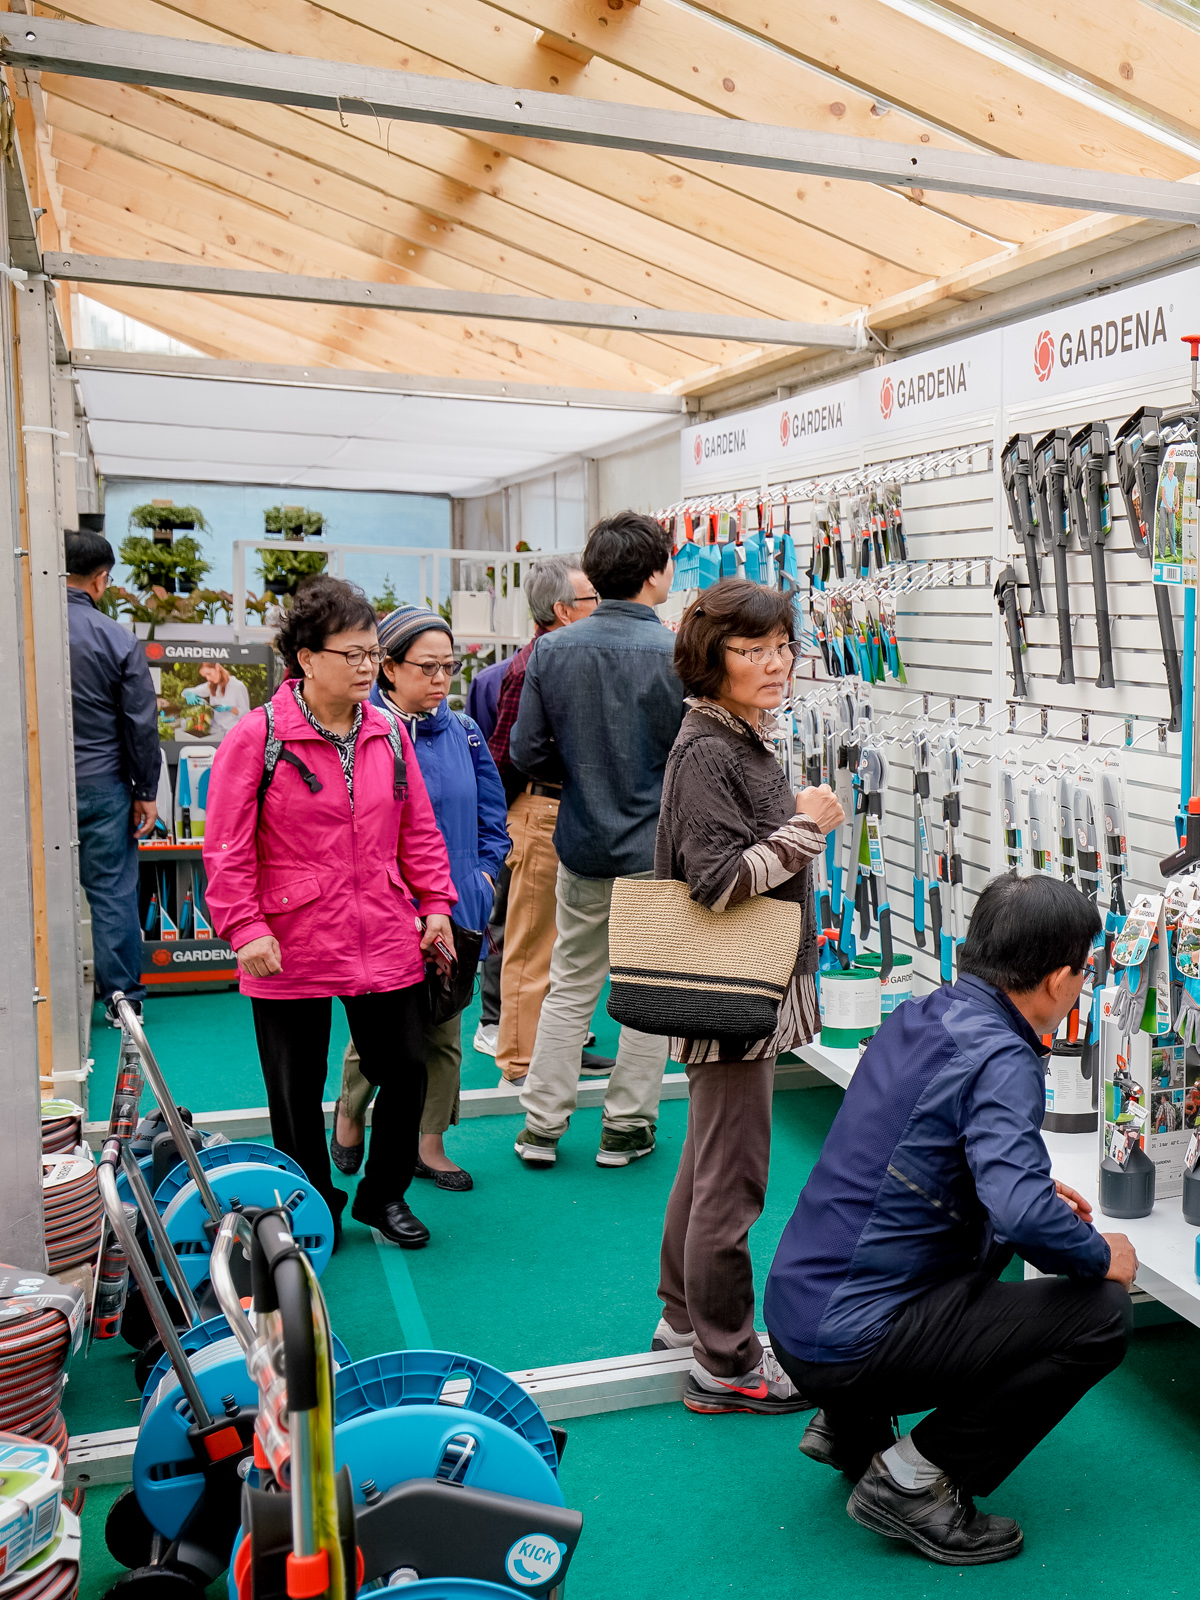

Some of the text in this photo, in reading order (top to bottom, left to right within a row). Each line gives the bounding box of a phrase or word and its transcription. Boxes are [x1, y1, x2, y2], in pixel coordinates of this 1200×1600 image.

[1059, 306, 1168, 367] GARDENA
[897, 362, 967, 408] GARDENA
[792, 402, 843, 438] GARDENA
[704, 429, 746, 458] GARDENA
[165, 646, 229, 659] GARDENA
[0, 1522, 20, 1541] lassic
[518, 1541, 557, 1566] KICK
